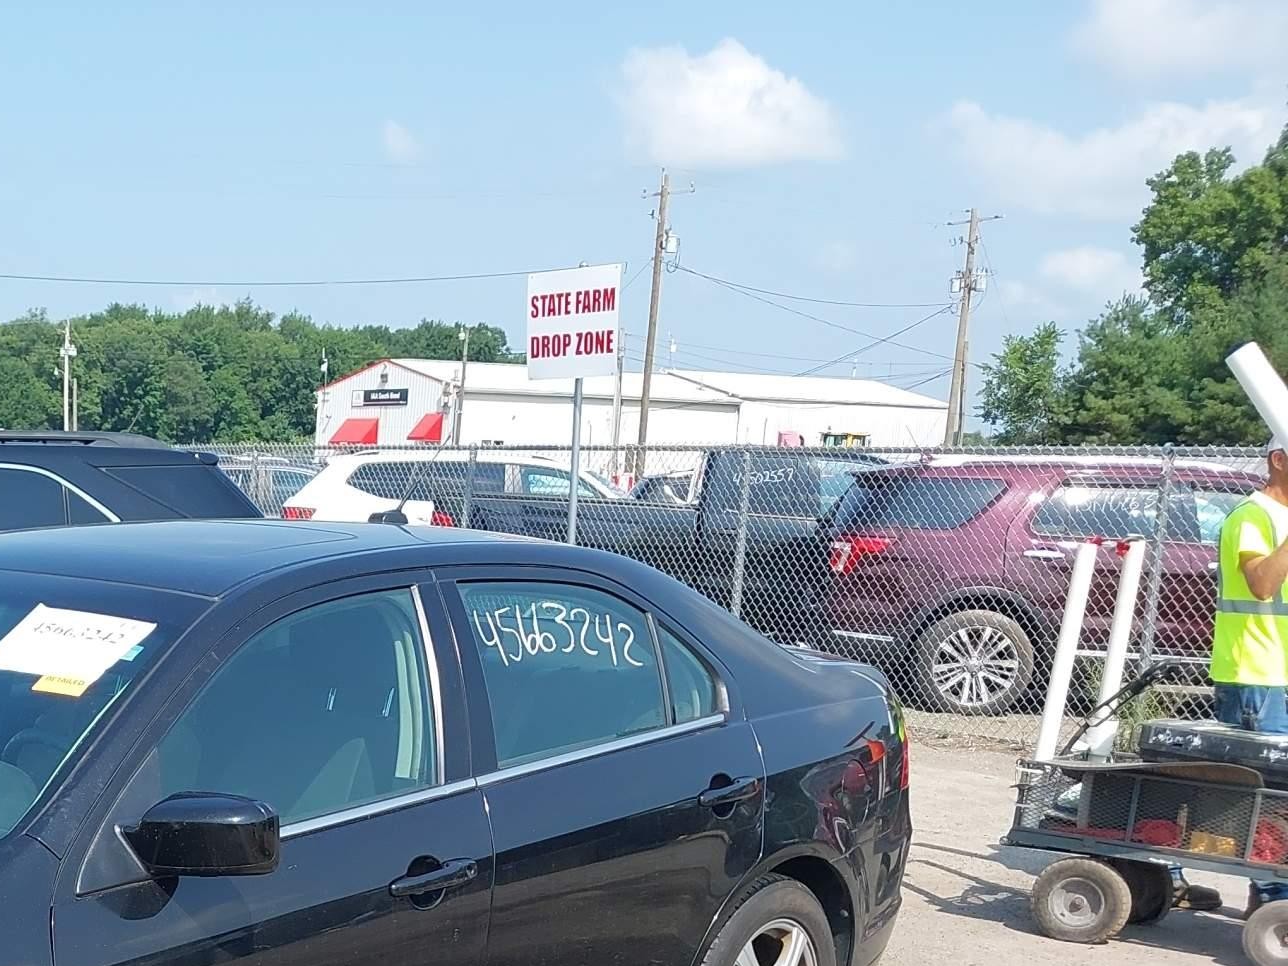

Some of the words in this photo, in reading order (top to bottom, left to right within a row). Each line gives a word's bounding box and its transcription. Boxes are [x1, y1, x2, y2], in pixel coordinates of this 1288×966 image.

[531, 292, 572, 318] STATE
[575, 287, 616, 314] FARM
[531, 334, 572, 359] DROP
[575, 330, 614, 355] ZONE
[733, 468, 794, 486] 4502557
[474, 602, 644, 667] 45663242
